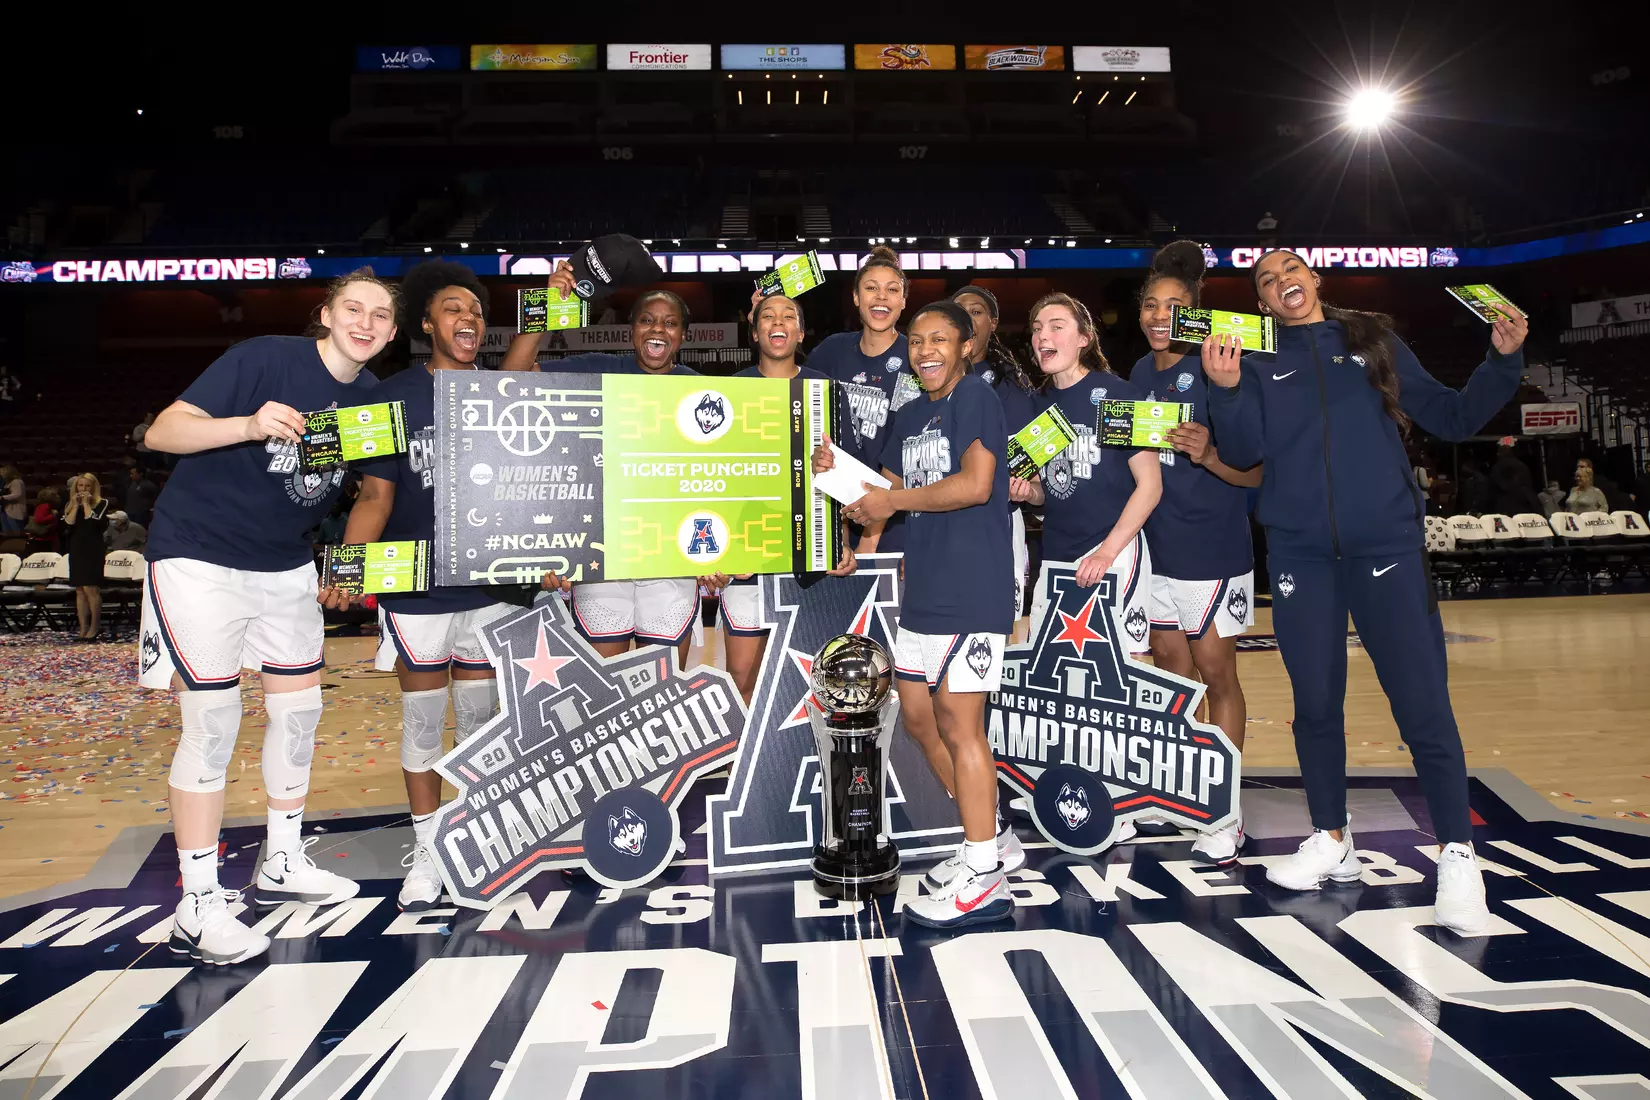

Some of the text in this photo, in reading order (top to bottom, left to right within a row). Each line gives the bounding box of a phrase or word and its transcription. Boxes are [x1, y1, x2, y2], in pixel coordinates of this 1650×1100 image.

[629, 51, 689, 64] Frontier
[1010, 54, 1038, 64] WOLVES
[602, 146, 633, 161] 106
[898, 145, 928, 160] 107
[1231, 247, 1428, 267] CMPIONS!
[52, 257, 277, 282] CHAMPIONS!
[580, 329, 724, 344] THEAMEG/WBB
[792, 400, 802, 415] 20
[847, 393, 890, 428] PIONS
[1524, 410, 1577, 427] ESPN
[268, 454, 297, 474] 20
[621, 462, 781, 478] TICKET PUNCHED
[793, 459, 803, 471] 16
[498, 465, 579, 483] WOMEN'S
[284, 478, 301, 504] UCONN
[493, 483, 595, 501] BASKETBALL
[679, 479, 727, 493] 2020
[484, 532, 588, 551] #NCAAW
[105, 558, 134, 567] MERICA
[629, 668, 652, 690] 20
[1141, 688, 1163, 705] 20
[988, 690, 1189, 741] OMEN'S BASKETBALL
[468, 682, 687, 812] WOMEN'S BASKETBALL
[481, 745, 507, 768] 20
[986, 709, 1225, 806] AMPIONSHIP
[443, 682, 732, 889] CHAMPIONSHIP
[0, 836, 1650, 949] WMEN'S BSKEBLL
